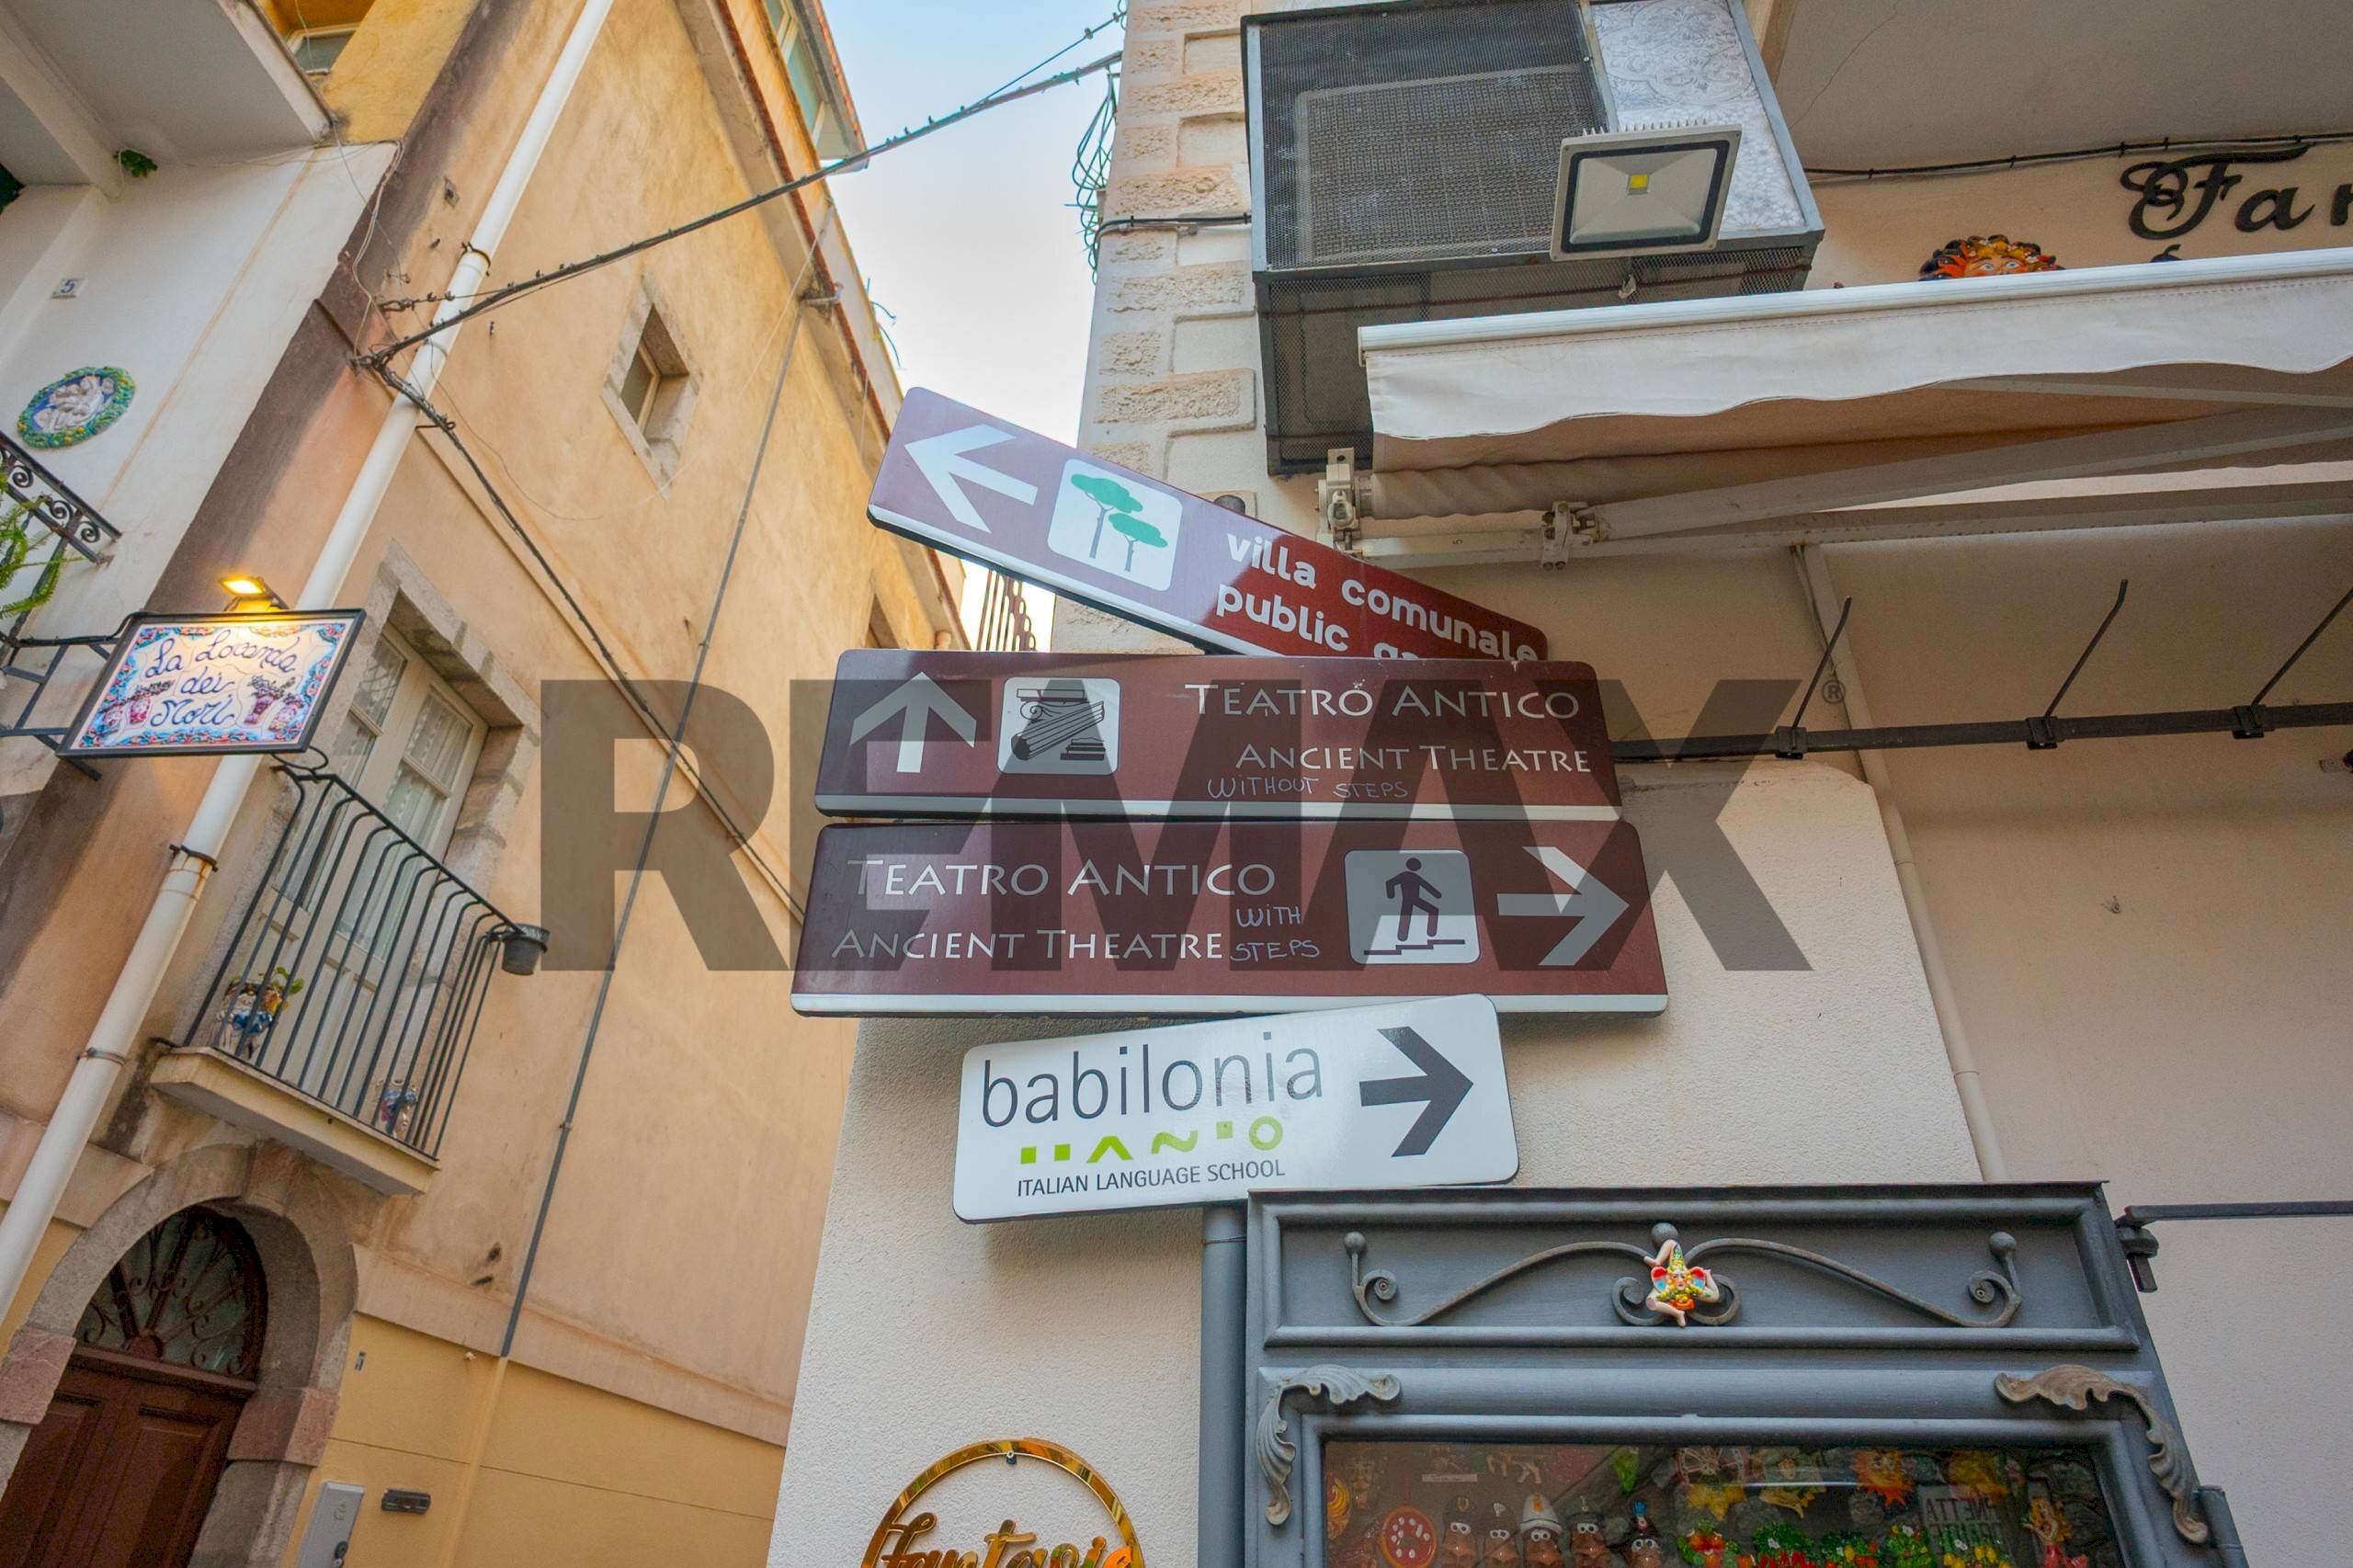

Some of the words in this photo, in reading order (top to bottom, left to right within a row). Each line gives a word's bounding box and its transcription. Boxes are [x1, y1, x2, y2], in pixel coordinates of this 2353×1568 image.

[1226, 532, 1317, 590] villa
[1341, 578, 1539, 661] comunale
[1215, 584, 1349, 653] public
[144, 637, 185, 679] La
[194, 629, 301, 674] Locanda
[180, 665, 235, 696] dei
[1184, 683, 1374, 718] TEATRO
[1392, 686, 1580, 720] ANTICO
[1234, 743, 1410, 771] ANCIENT
[1418, 744, 1591, 774] THEATRE
[1333, 781, 1408, 799] STEPS
[846, 858, 1049, 897] TEATRO
[1067, 858, 1277, 897] ANTICO
[831, 929, 1025, 960] ANCIENT
[1037, 929, 1223, 960] THEATRE
[1230, 939, 1321, 962] STEPS
[981, 1030, 1324, 1129] babilonia
[1017, 1174, 1089, 1198] ITALIAN
[1095, 1165, 1201, 1192] LANGUAGE
[1206, 1158, 1286, 1183] SCHOOL
